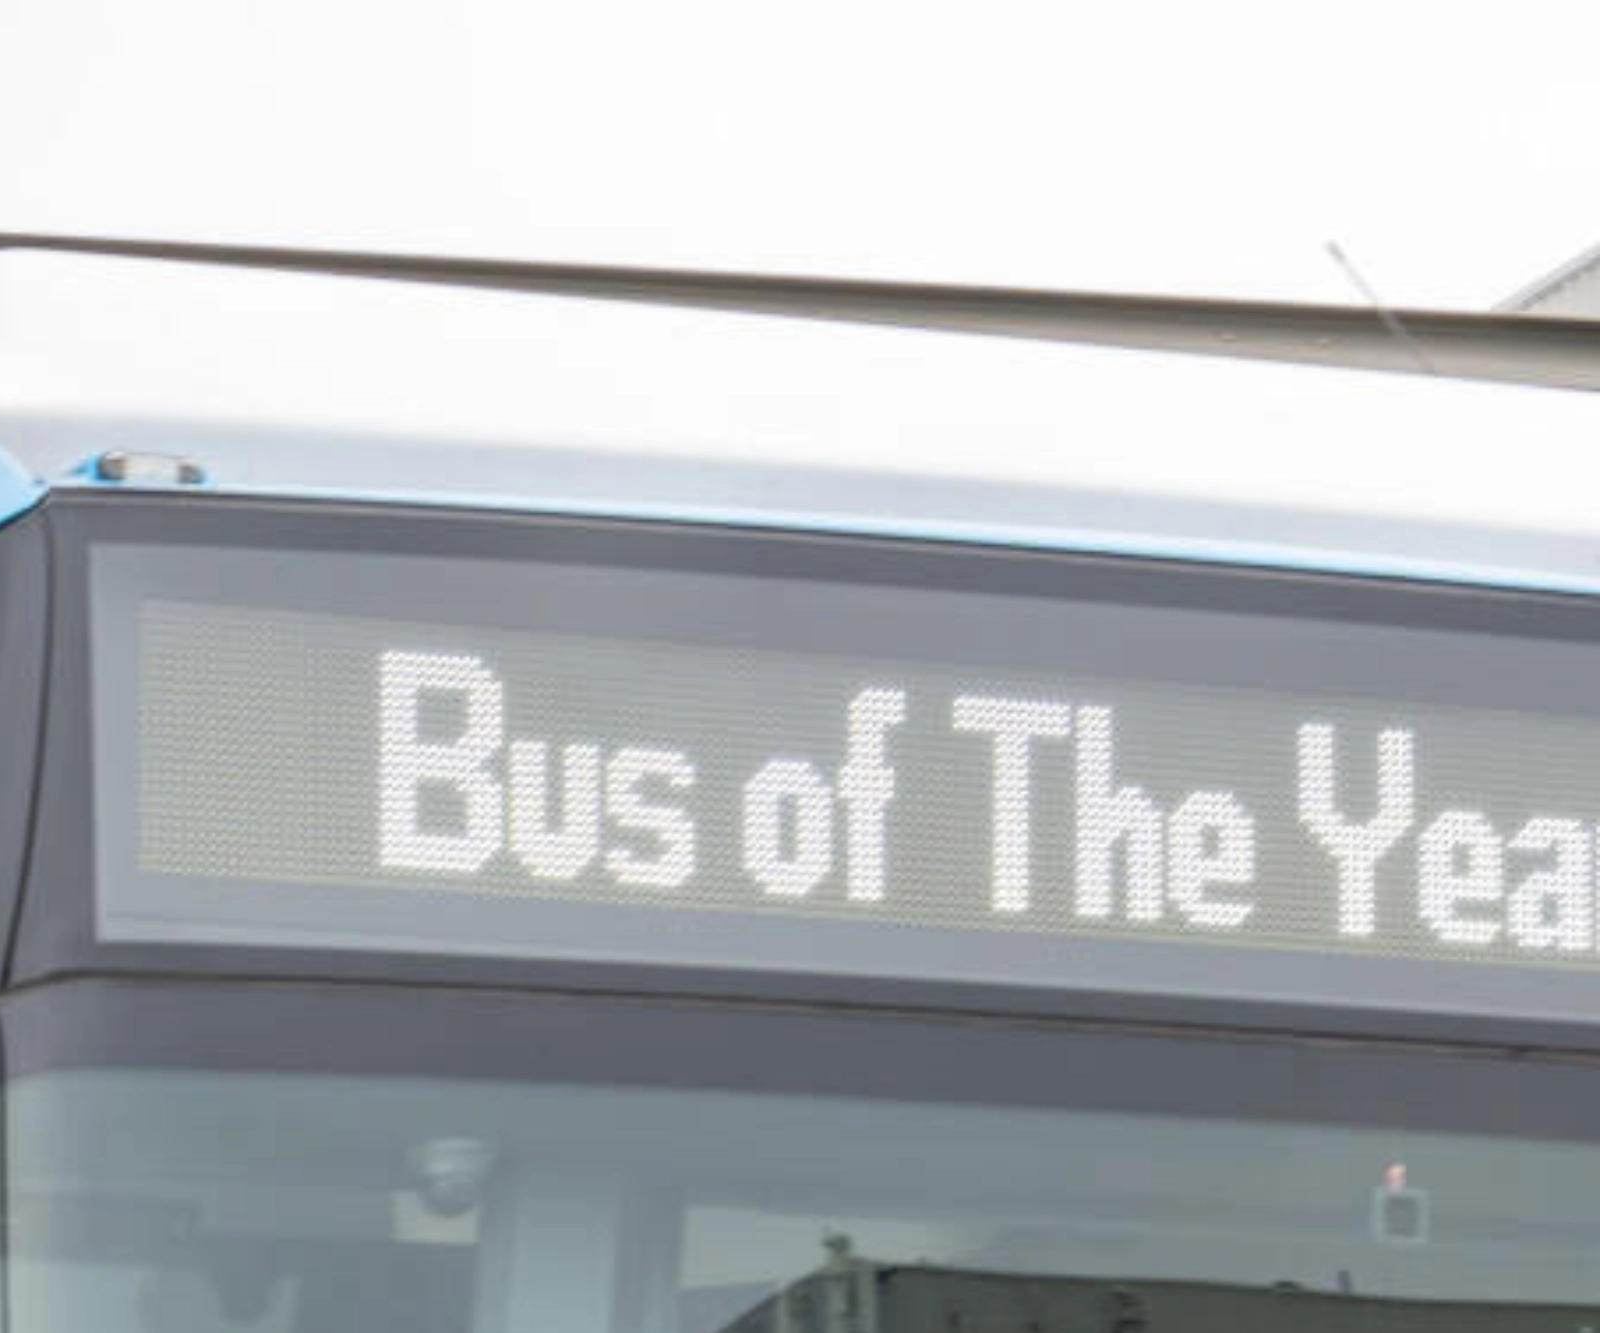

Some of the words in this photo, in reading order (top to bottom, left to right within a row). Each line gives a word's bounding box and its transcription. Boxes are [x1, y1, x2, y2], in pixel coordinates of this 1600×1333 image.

[379, 650, 696, 888] Bus
[742, 687, 906, 901] of
[952, 696, 1255, 926] The
[1297, 722, 1600, 950] Yea
